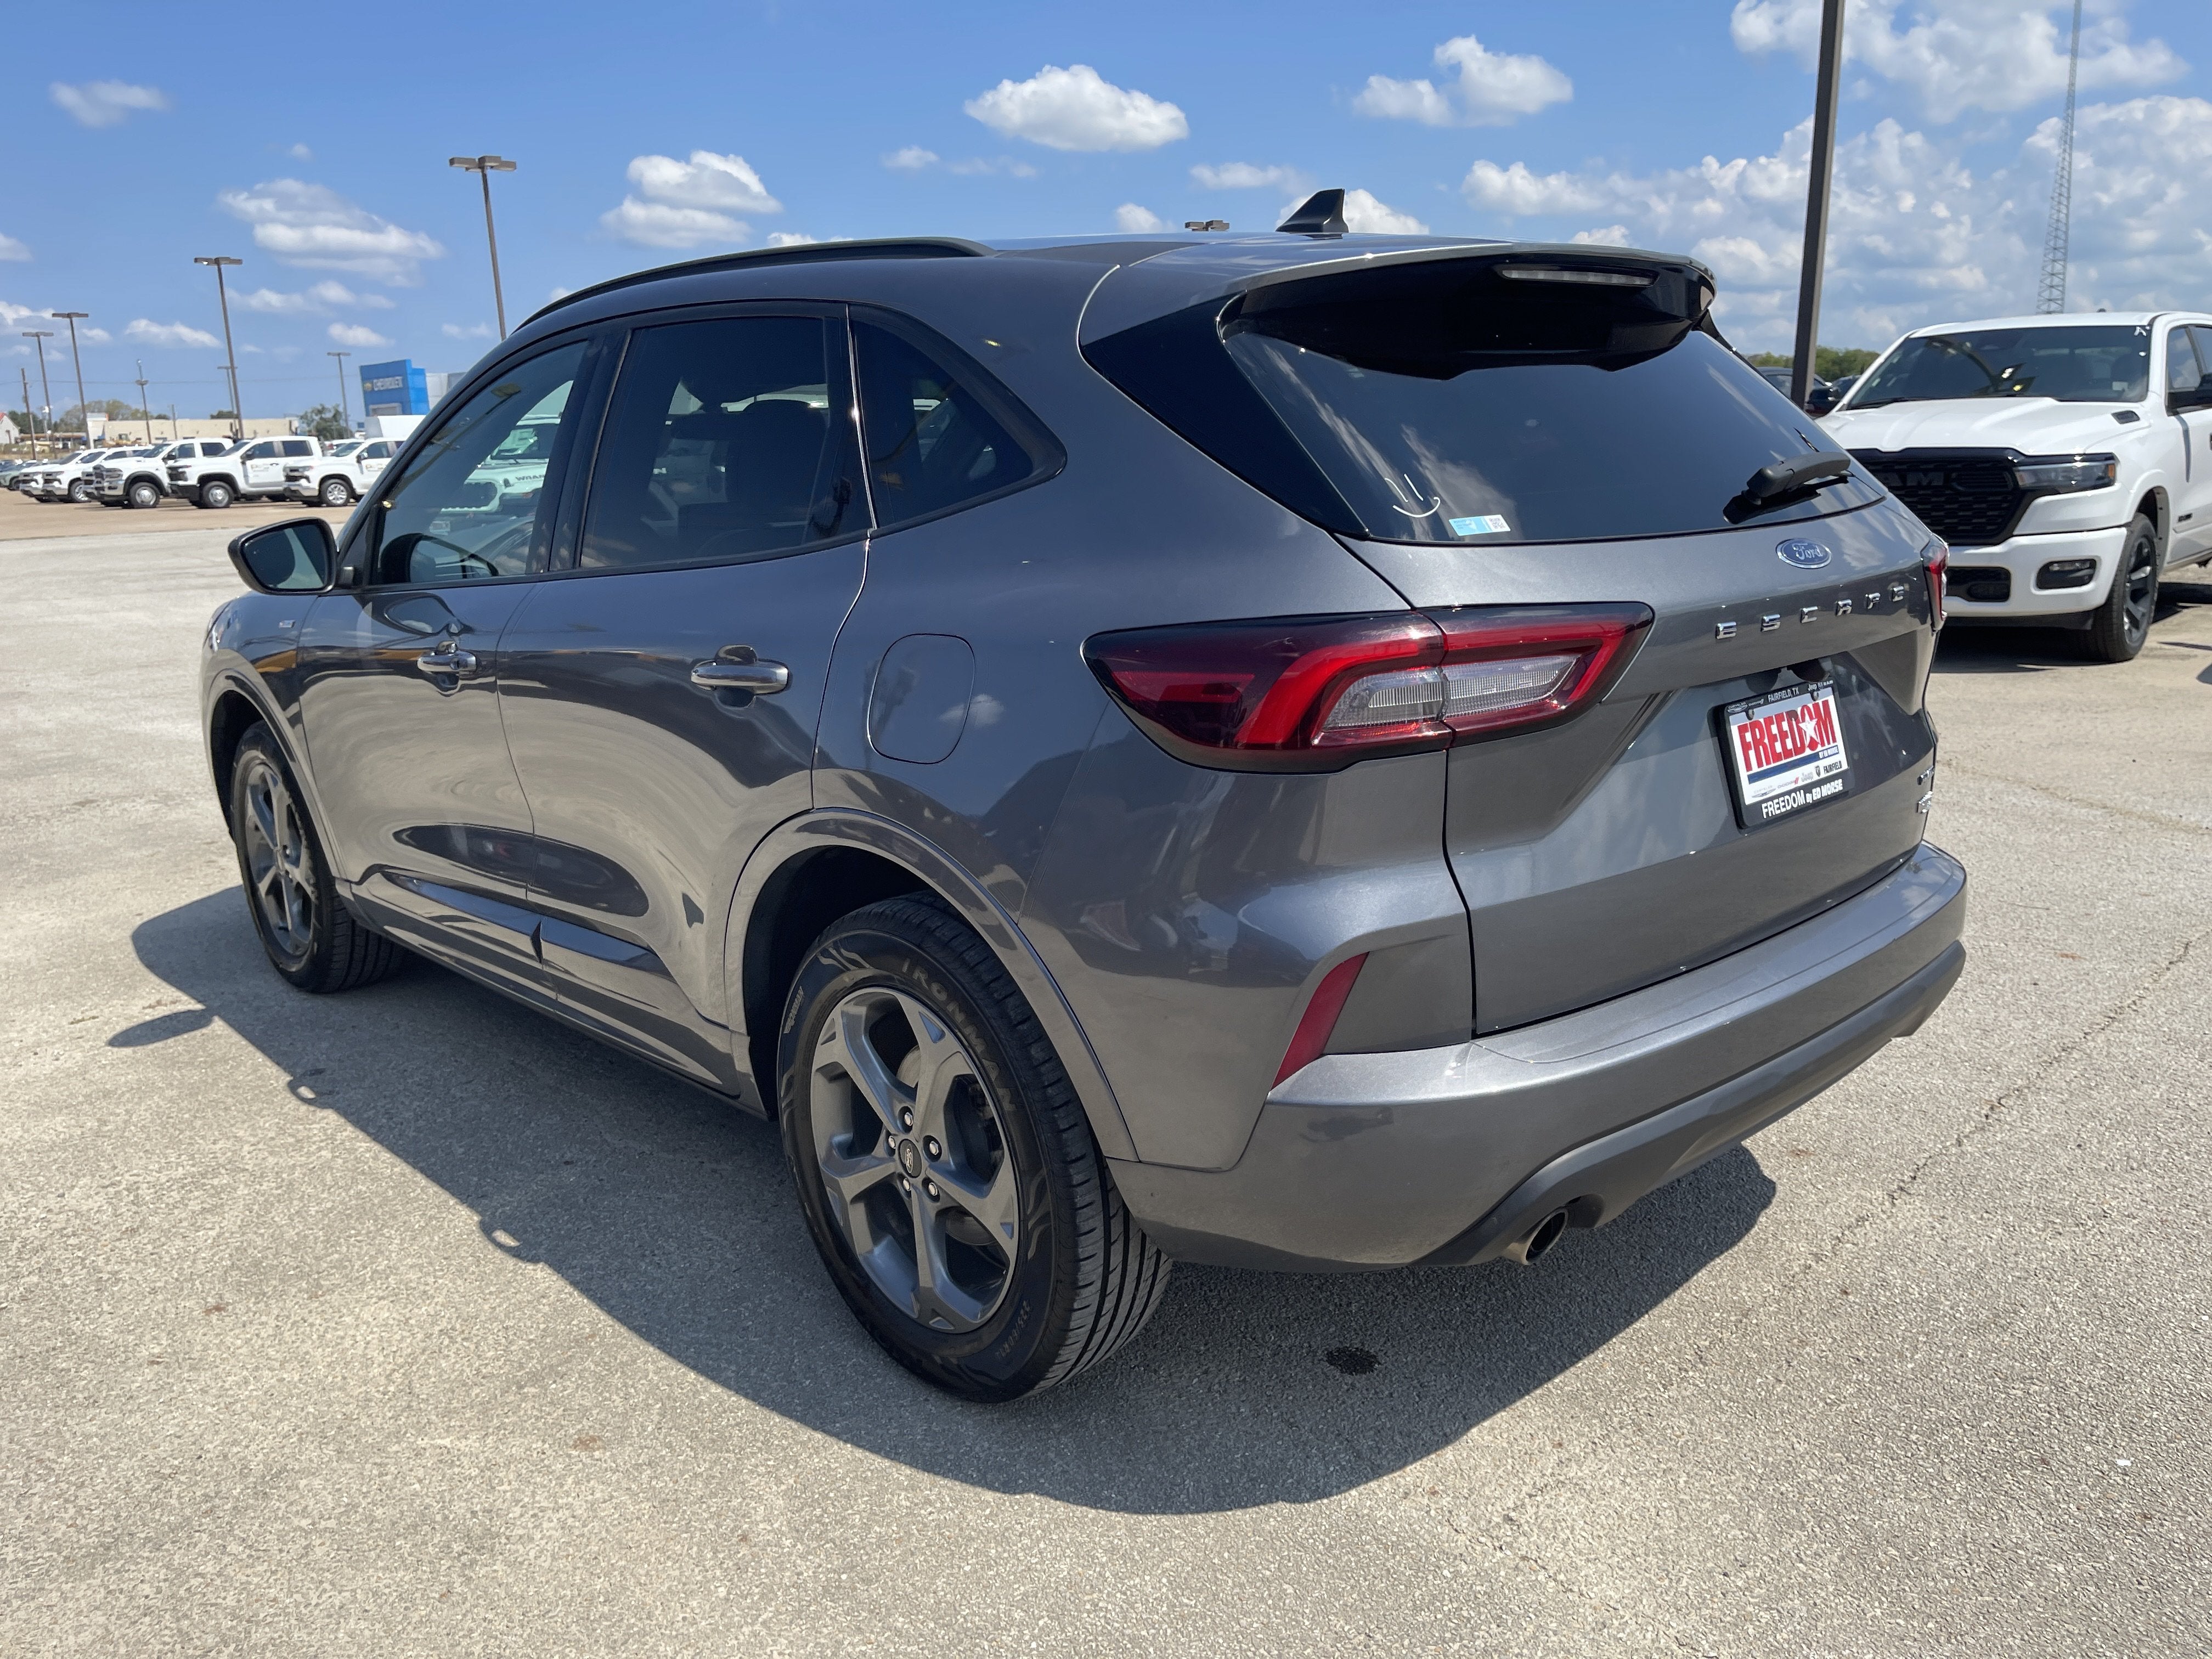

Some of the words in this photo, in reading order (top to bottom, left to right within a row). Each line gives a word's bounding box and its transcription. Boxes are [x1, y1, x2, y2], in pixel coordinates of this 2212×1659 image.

[1793, 543, 1825, 560] Ford
[1716, 585, 1906, 640] ESCAPE
[1768, 690, 1793, 703] FAIRFIELD,
[1792, 687, 1799, 696] TX
[1737, 699, 1837, 772] FREEDOM
[1801, 771, 1814, 782] Jeep
[1823, 760, 1842, 775] FAIRFIELD
[1762, 789, 1805, 819] FREEDOM
[1812, 787, 1821, 800] ED
[1821, 778, 1843, 797] MORSE
[901, 958, 1018, 1111] IRONMAN
